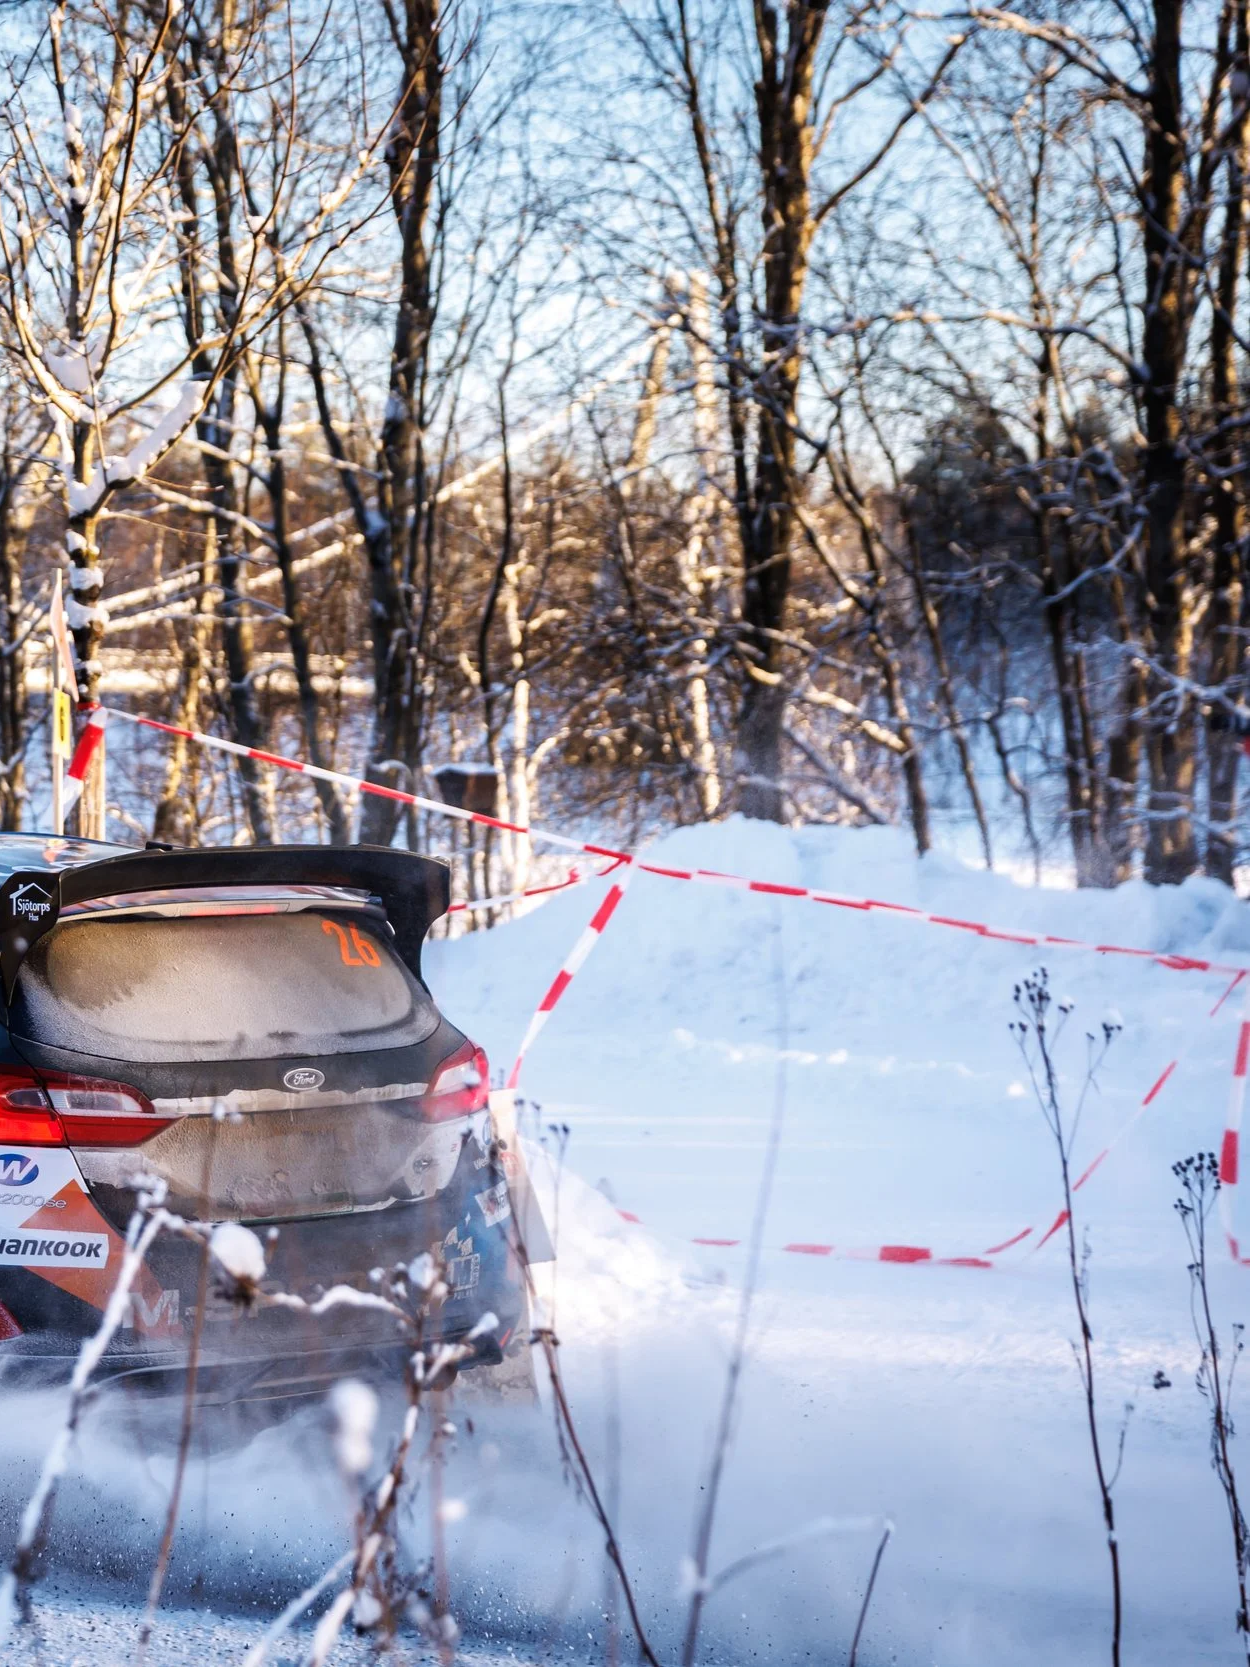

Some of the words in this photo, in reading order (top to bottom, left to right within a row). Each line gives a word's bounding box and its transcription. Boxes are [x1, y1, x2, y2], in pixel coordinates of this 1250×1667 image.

[17, 898, 51, 916] Sjötorps
[321, 919, 382, 968] 26
[293, 1072, 316, 1085] Ford
